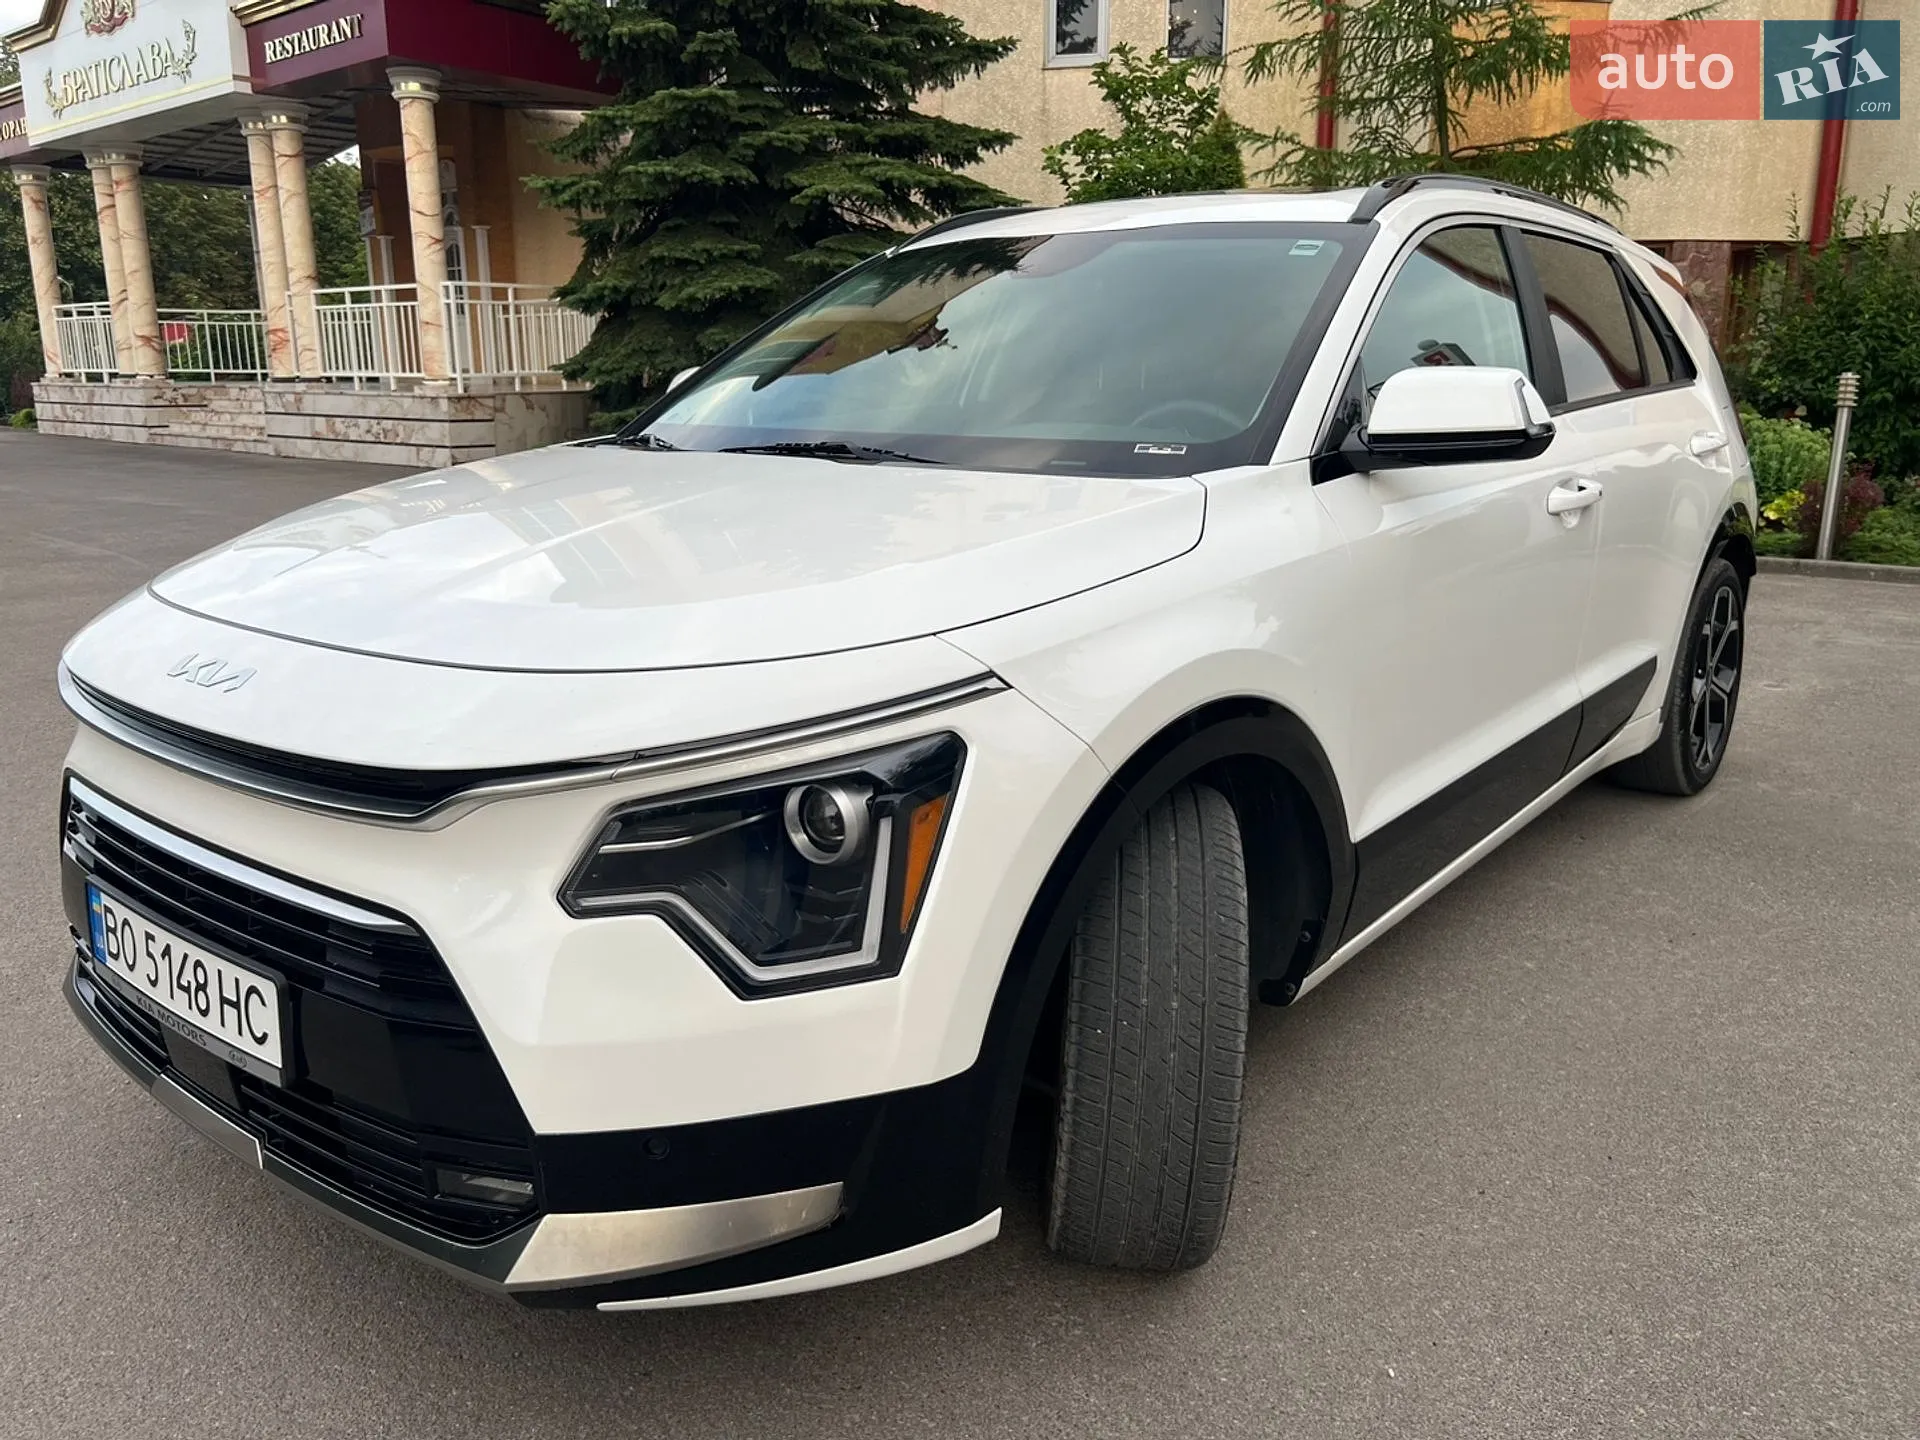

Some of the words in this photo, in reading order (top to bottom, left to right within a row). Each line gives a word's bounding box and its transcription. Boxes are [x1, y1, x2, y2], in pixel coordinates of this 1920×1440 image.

[264, 13, 363, 64] RESTAURANT
[60, 37, 176, 107] БРАТІСЛАВА
[0, 117, 28, 141] ОРАН
[166, 652, 258, 693] KIA
[103, 903, 137, 972] BO
[144, 930, 211, 1018] 5148
[217, 968, 269, 1046] HC
[136, 995, 155, 1015] KIA
[157, 1010, 207, 1047] MOTORS
